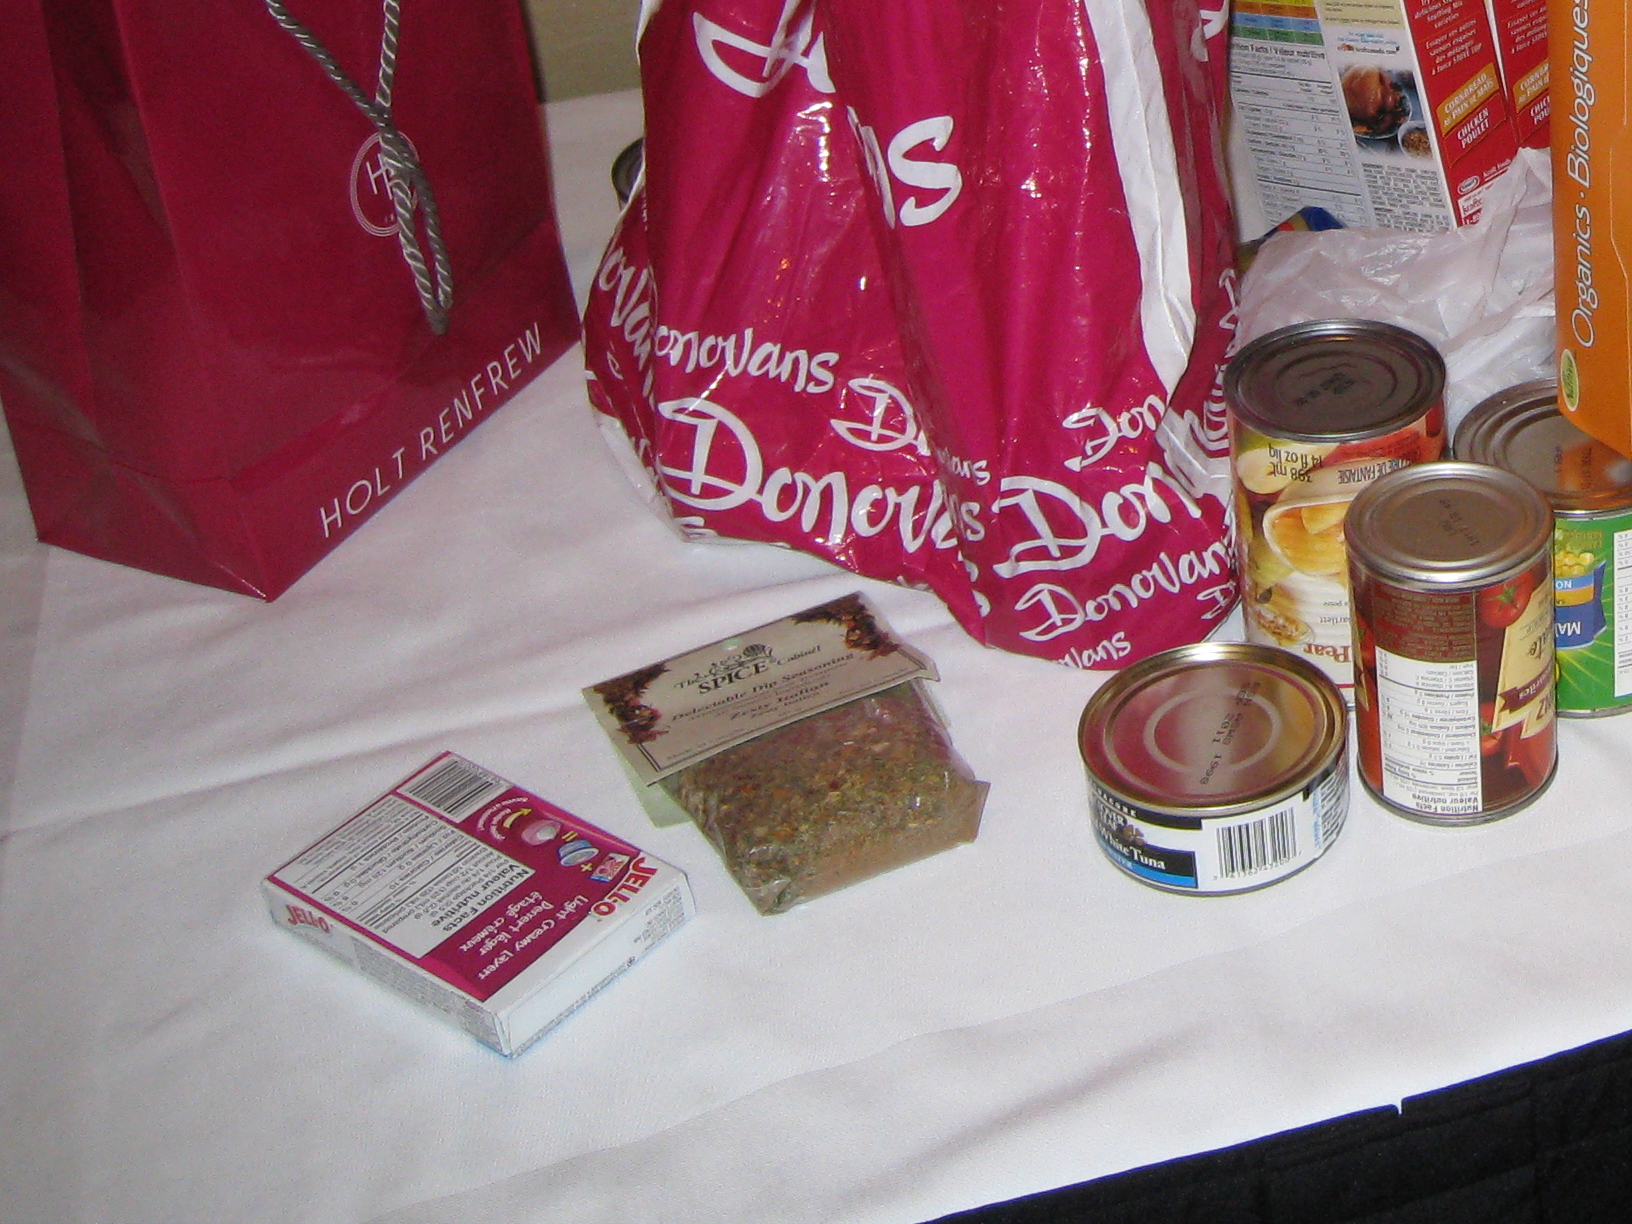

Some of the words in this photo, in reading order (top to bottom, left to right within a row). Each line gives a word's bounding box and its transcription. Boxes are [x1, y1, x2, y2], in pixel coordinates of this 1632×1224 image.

[1443, 73, 1487, 114] CORNBREAD
[1457, 108, 1490, 141] CHICKEN
[1461, 119, 1490, 149] POULET
[1570, 200, 1598, 349] Organics
[654, 327, 840, 395] onovans
[319, 447, 409, 540] HOLT
[419, 321, 546, 458] RENFREW
[1268, 443, 1283, 465] liq
[1284, 450, 1298, 463] oz
[1290, 466, 1313, 483] 398
[1337, 462, 1377, 484] FANTAISIE
[1014, 536, 1239, 642] Donovan
[1319, 616, 1350, 626] artlett
[1303, 643, 1352, 664] Pear
[672, 691, 748, 721] Delectable
[751, 680, 778, 694] Dip
[782, 652, 855, 682] Seasoning
[698, 660, 770, 695] SPICE
[1130, 846, 1166, 870] Tuna
[477, 868, 530, 907] Nutrition
[480, 863, 521, 892] Valeur
[593, 856, 659, 917] JELL-O
[430, 889, 481, 928] nutritive
[441, 906, 479, 932] Facts
[511, 899, 555, 933] Dessert
[556, 894, 589, 921] Light
[458, 916, 506, 953] crémeux
[479, 932, 512, 957] léger
[514, 919, 556, 952] Creamy
[477, 949, 515, 981] Layers
